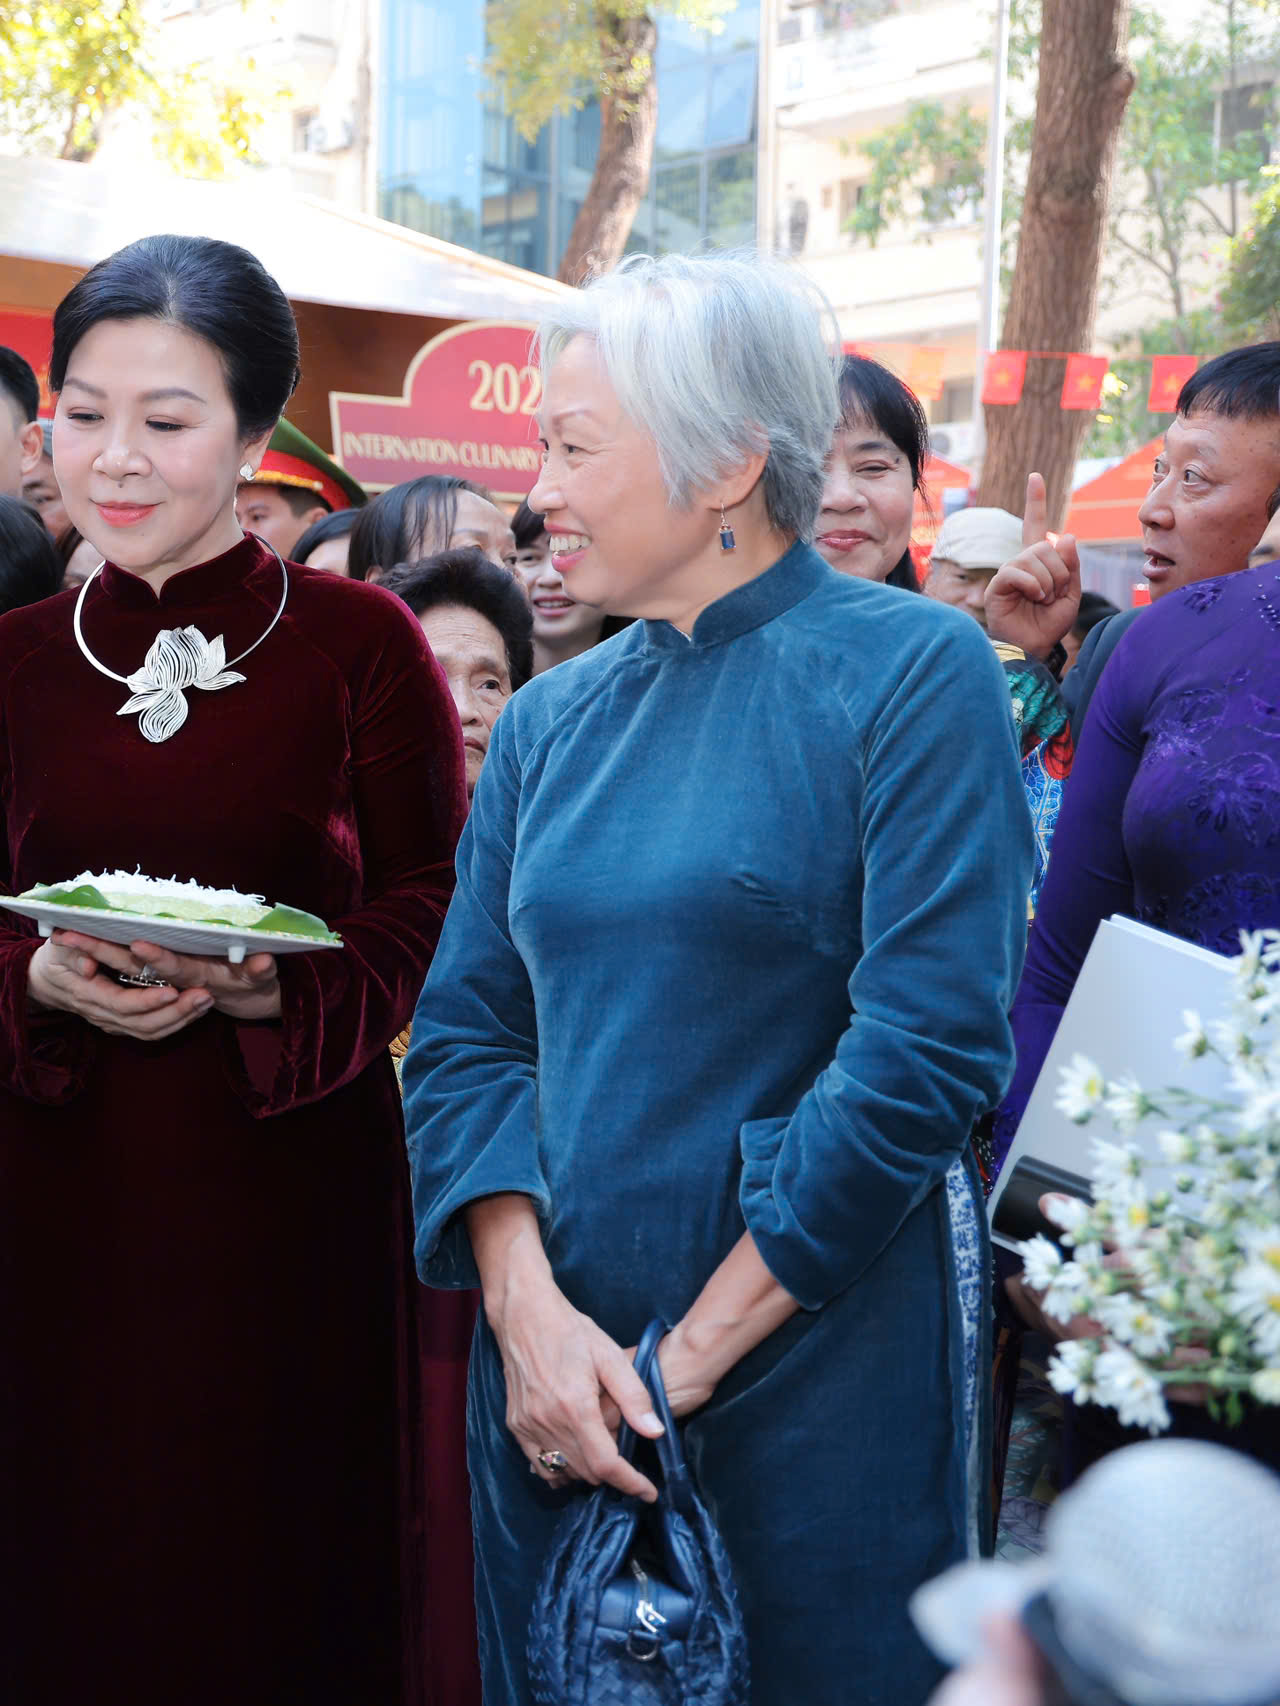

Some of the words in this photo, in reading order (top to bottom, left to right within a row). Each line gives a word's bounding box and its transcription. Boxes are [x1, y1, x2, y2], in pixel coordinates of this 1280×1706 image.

[468, 359, 544, 415] 202
[342, 431, 458, 467] INTERNATION
[460, 440, 539, 472] CULINARY
